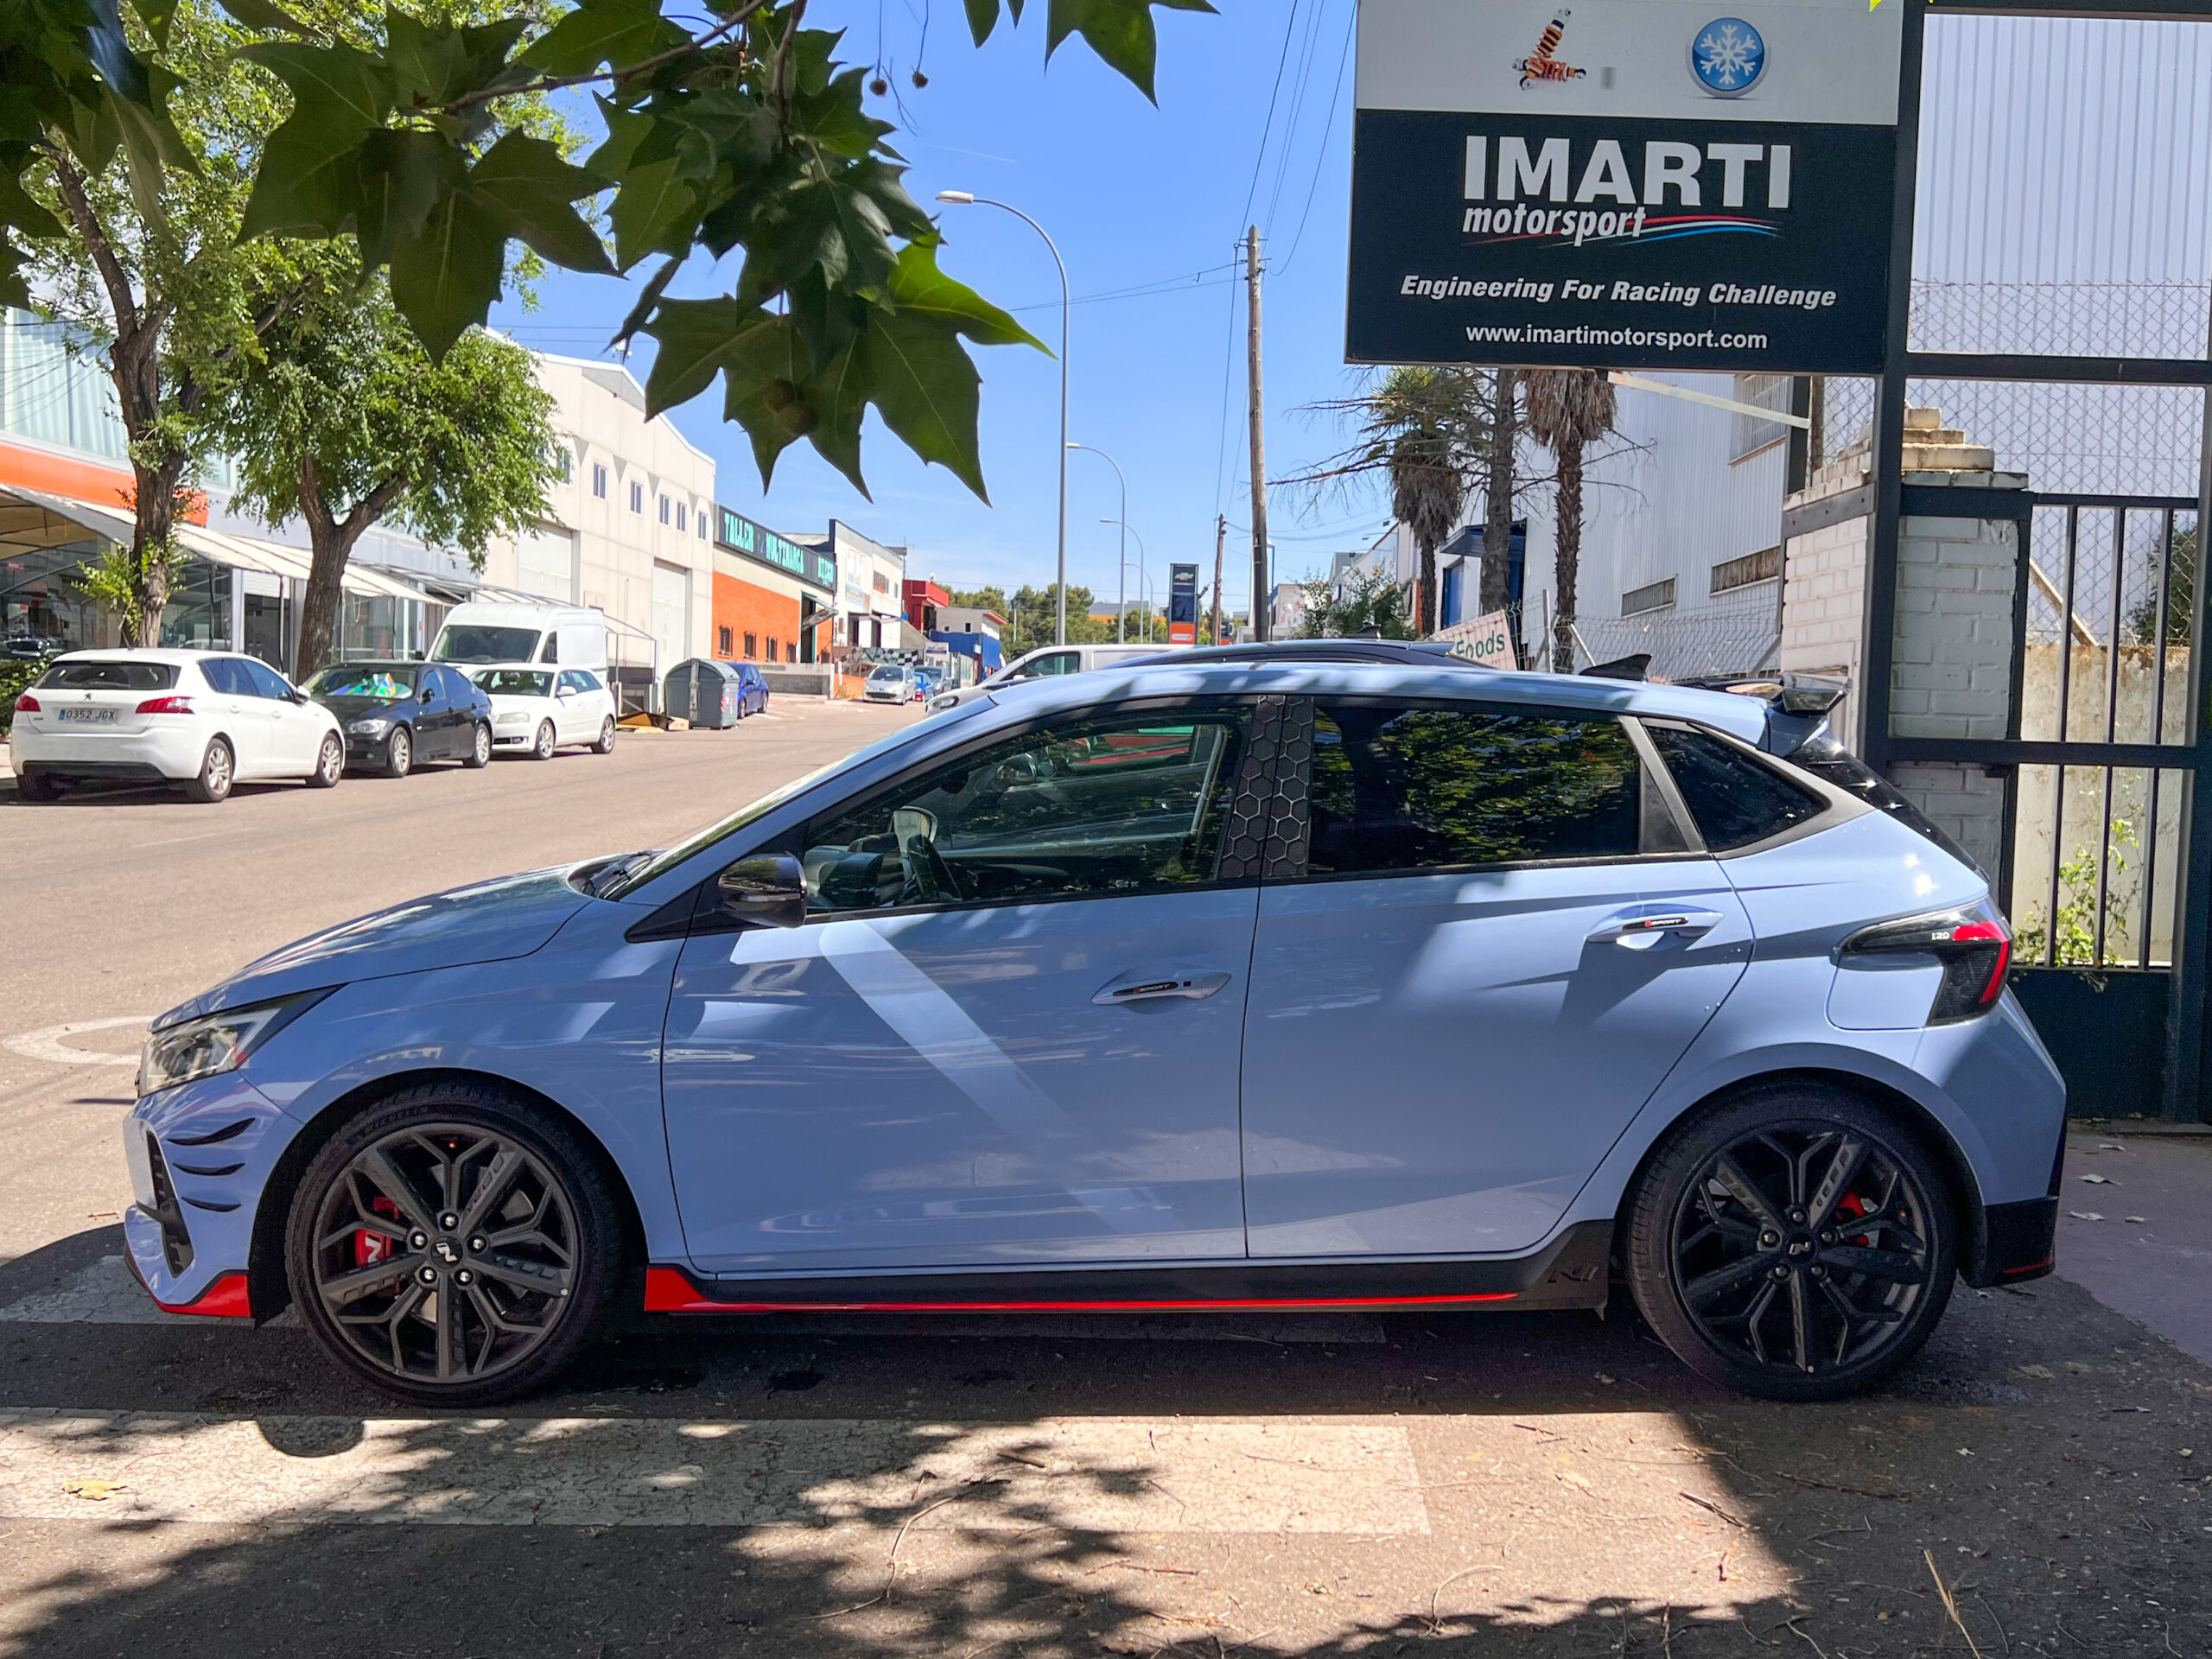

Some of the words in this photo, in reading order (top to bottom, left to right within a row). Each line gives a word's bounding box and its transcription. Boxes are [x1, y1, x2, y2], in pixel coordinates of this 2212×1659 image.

[1464, 135, 1791, 209] IMARTI
[1462, 202, 1647, 247] motorsport
[1400, 275, 1554, 302] Engineering
[1560, 279, 1605, 301] For
[1610, 281, 1700, 307] Racing
[1707, 283, 1837, 309] Challenge
[1465, 323, 1768, 351] www.imartimotorsport.com
[724, 512, 754, 553] TALLER
[66, 709, 92, 719] 0352
